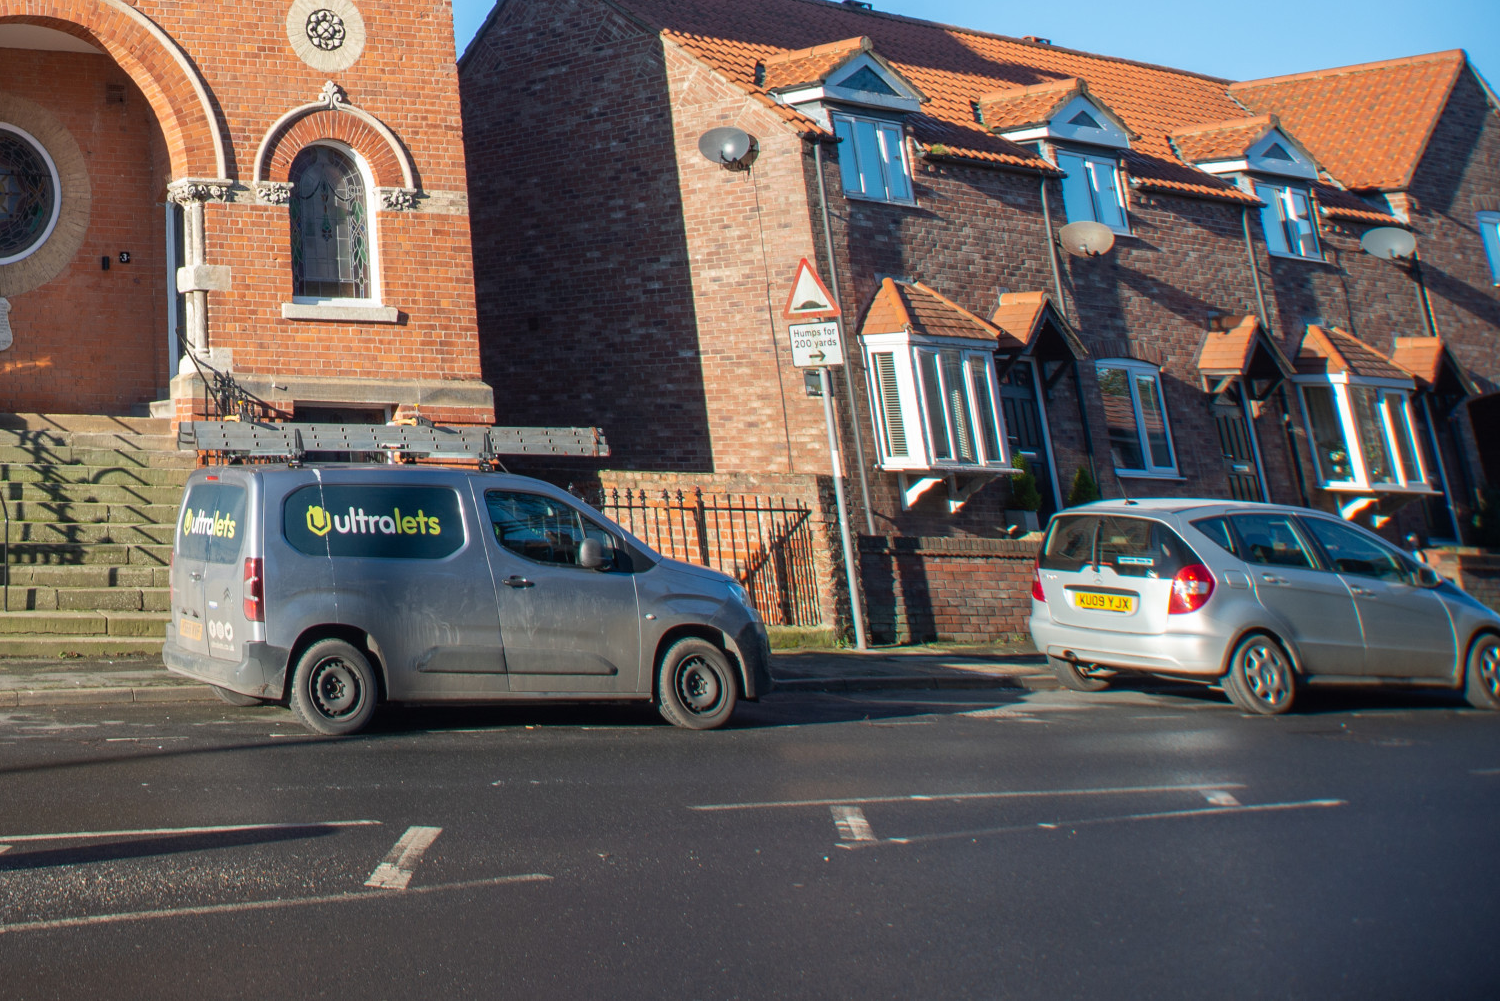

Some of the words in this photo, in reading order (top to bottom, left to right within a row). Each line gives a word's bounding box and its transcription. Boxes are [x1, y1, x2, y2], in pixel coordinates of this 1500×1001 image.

[793, 328, 821, 338] Humps
[823, 327, 835, 335] for
[794, 339, 812, 348] 200
[814, 338, 837, 348] yards
[192, 509, 236, 539] ultralets
[334, 506, 441, 535] ultralets
[1079, 594, 1105, 607] KU09
[1108, 596, 1129, 609] YJX
